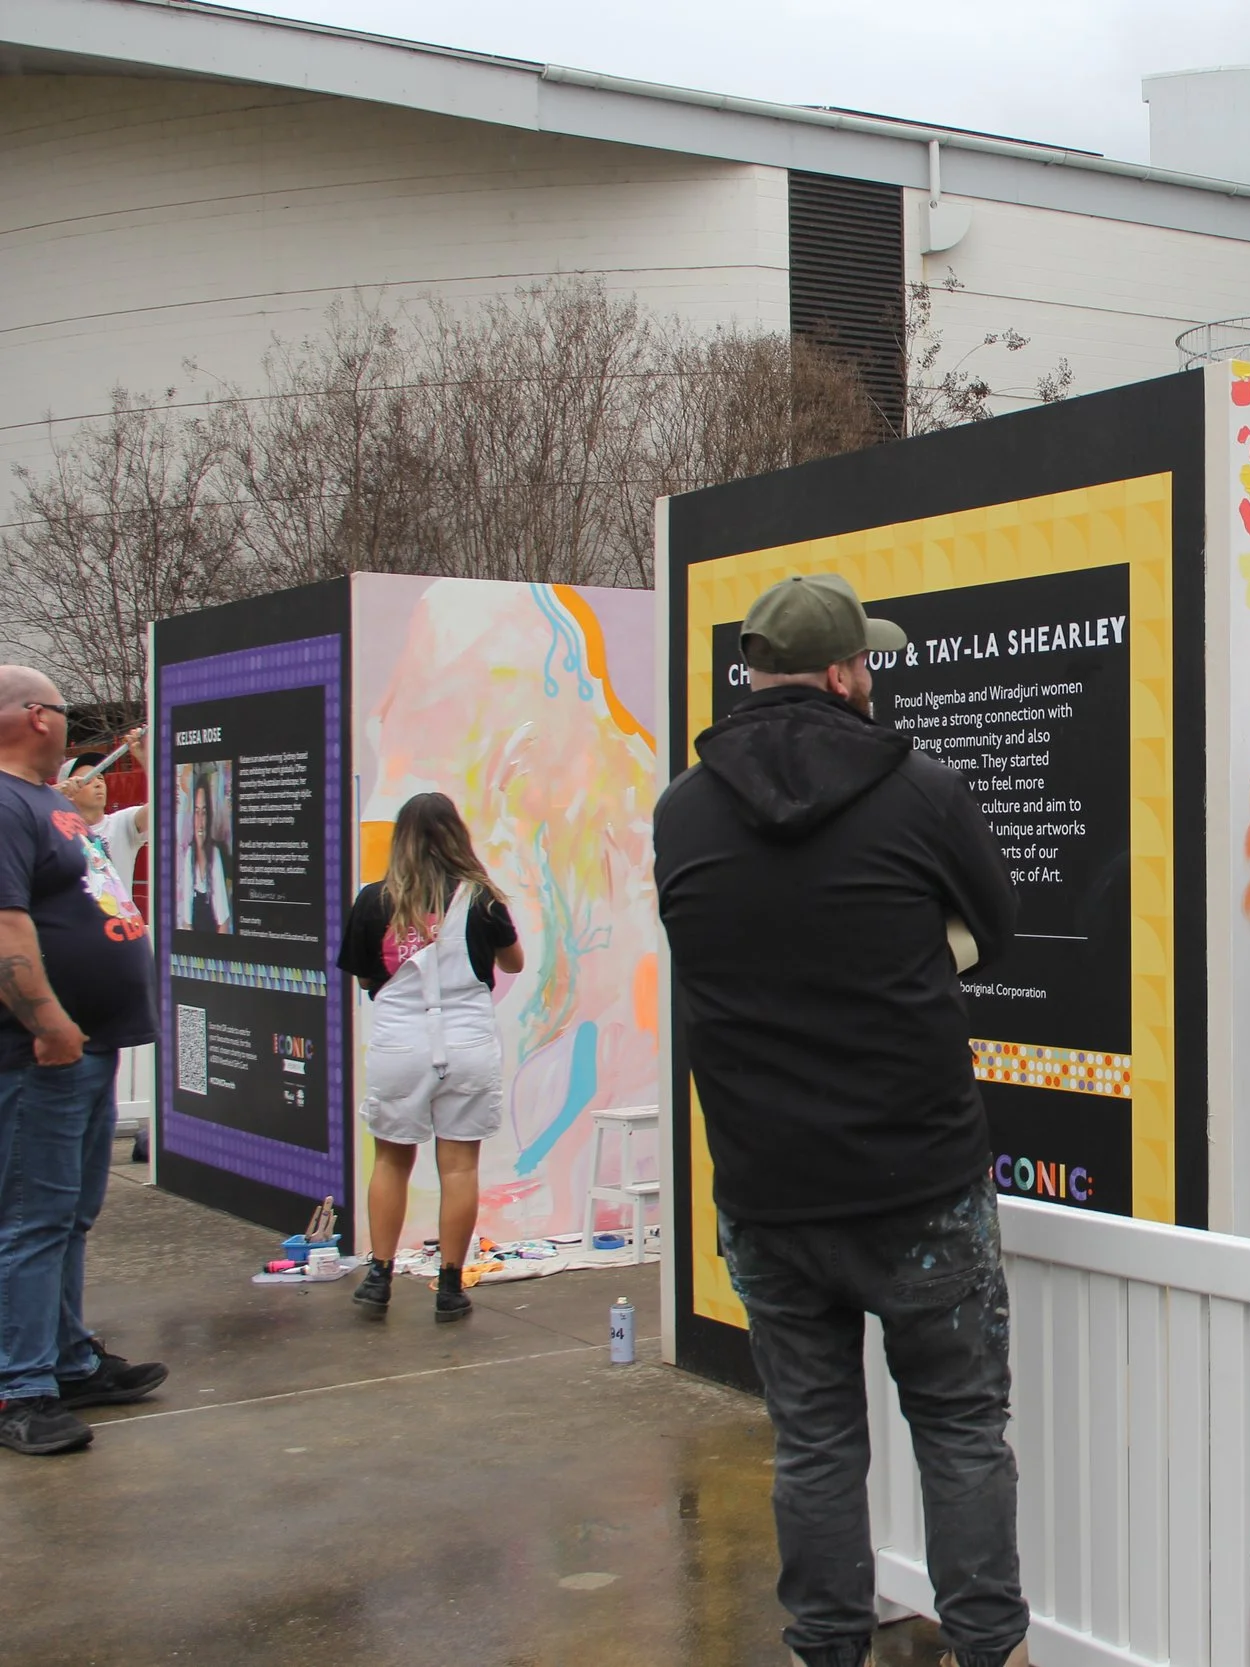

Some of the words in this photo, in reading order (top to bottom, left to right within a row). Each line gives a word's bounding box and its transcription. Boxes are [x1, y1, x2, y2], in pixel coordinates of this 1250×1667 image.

[864, 650, 897, 671] OD
[906, 642, 919, 667] &
[926, 633, 999, 664] TAY-LA
[1008, 615, 1126, 656] SHEARLEY
[895, 692, 923, 709] Proud
[925, 690, 966, 710] Ngemba
[968, 687, 988, 702] and
[989, 683, 1039, 703] Wiradjuri
[1041, 681, 1083, 697] women
[895, 715, 916, 730] who
[917, 714, 940, 729] have
[942, 716, 948, 727] a
[950, 713, 983, 729] strong
[984, 706, 1045, 724] connection
[1048, 703, 1073, 719] with
[175, 729, 202, 746] KELSEA
[202, 727, 222, 743] ROSE
[913, 735, 942, 753] Darug
[943, 732, 1003, 750] community
[1005, 729, 1025, 745] and
[1027, 728, 1051, 743] also
[948, 756, 980, 770] home.
[981, 753, 1008, 771] They
[1010, 750, 1050, 767] started
[977, 779, 989, 792] to
[991, 775, 1013, 791] feel
[1015, 778, 1045, 790] more
[981, 798, 1021, 814] culture
[1023, 797, 1044, 813] and
[1046, 798, 1067, 812] aim
[1069, 798, 1082, 812] to
[996, 822, 1034, 840] unique
[1036, 820, 1086, 836] artworks
[1024, 843, 1037, 859] of
[1038, 847, 1059, 859] our
[1027, 867, 1041, 882] of
[1041, 867, 1063, 882] Art.
[996, 983, 1047, 1000] Corporation
